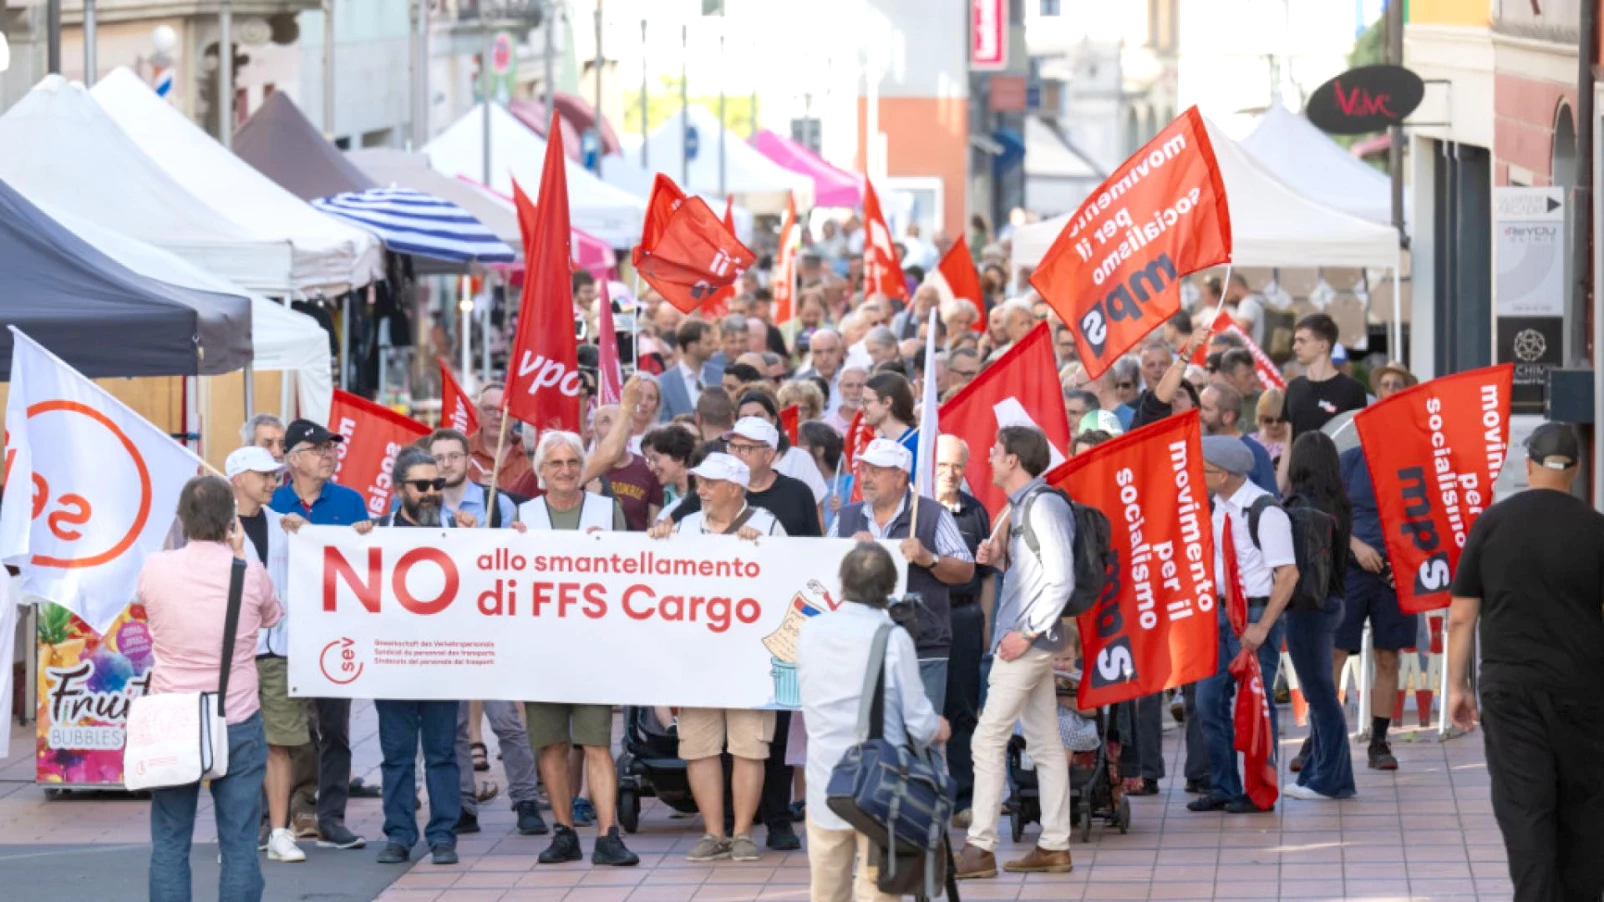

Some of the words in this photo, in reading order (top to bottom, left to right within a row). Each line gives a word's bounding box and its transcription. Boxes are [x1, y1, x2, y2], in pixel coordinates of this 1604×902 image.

[1426, 397, 1467, 549] socialismo
[1116, 467, 1157, 629] socialismo
[1168, 440, 1214, 613] movimento
[1397, 466, 1450, 591] mps
[322, 545, 460, 615] NO
[477, 548, 527, 571] allo
[535, 551, 761, 578] smantellamento
[1153, 540, 1181, 591] per
[477, 579, 517, 616] di
[532, 581, 608, 619] FFS
[621, 584, 762, 633] Cargo
[1166, 599, 1194, 622] il
[341, 637, 355, 672] sev
[51, 729, 122, 747] BUBBLES
